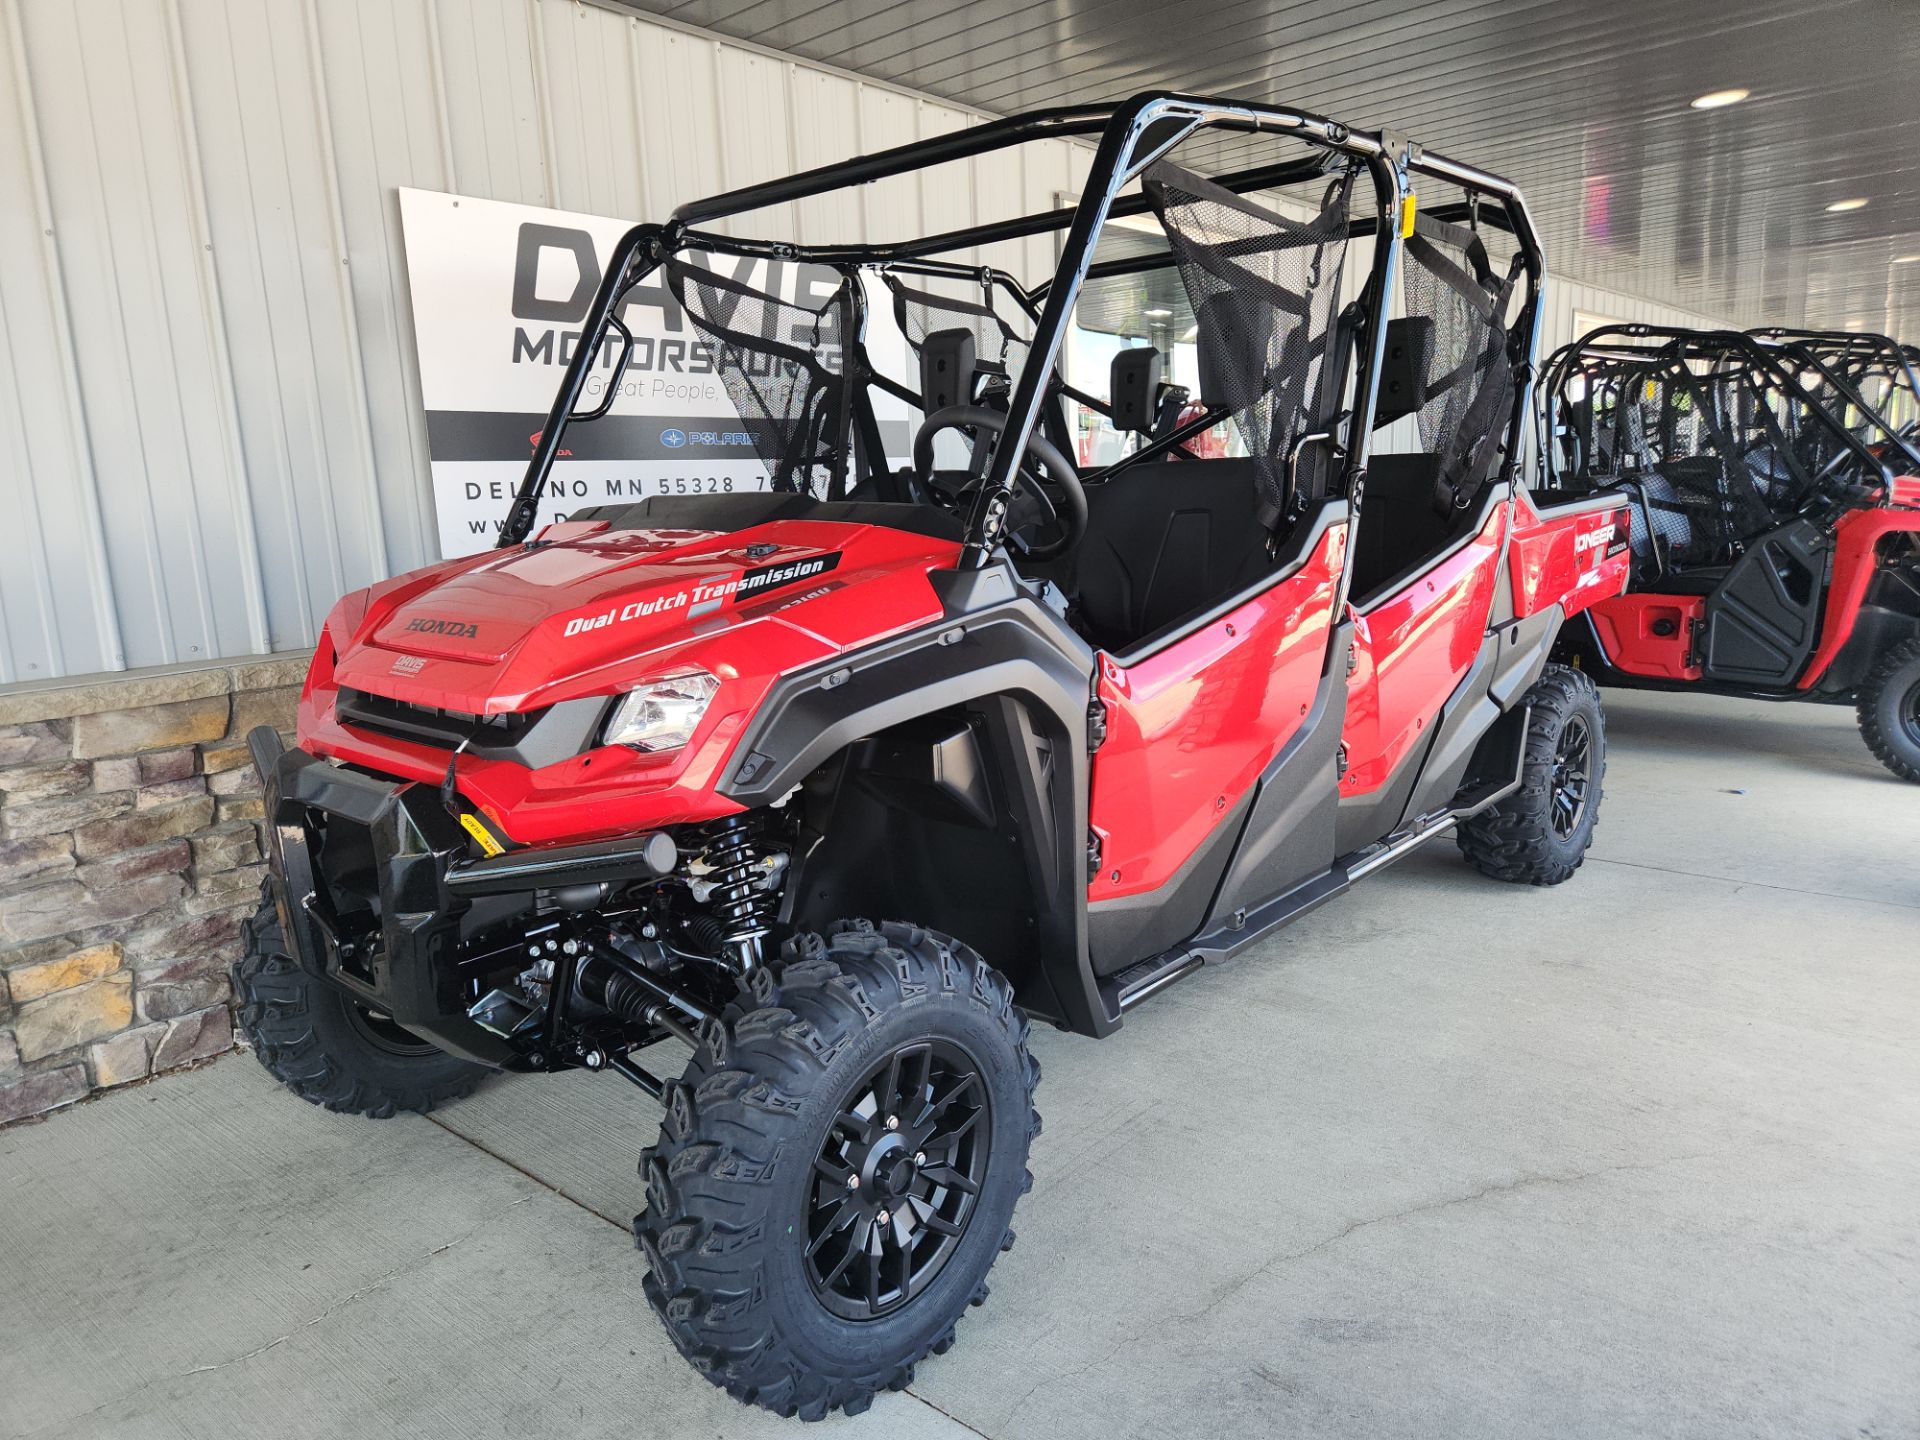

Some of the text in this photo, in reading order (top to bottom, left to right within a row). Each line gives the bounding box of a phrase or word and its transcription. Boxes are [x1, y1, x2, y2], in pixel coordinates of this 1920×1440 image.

[652, 379, 719, 403] People,
[465, 477, 733, 500] DELNO MN 55328
[563, 605, 616, 637] Dual
[619, 591, 687, 621] Clutch
[691, 559, 824, 603] Transmission
[405, 619, 479, 638] HONDA
